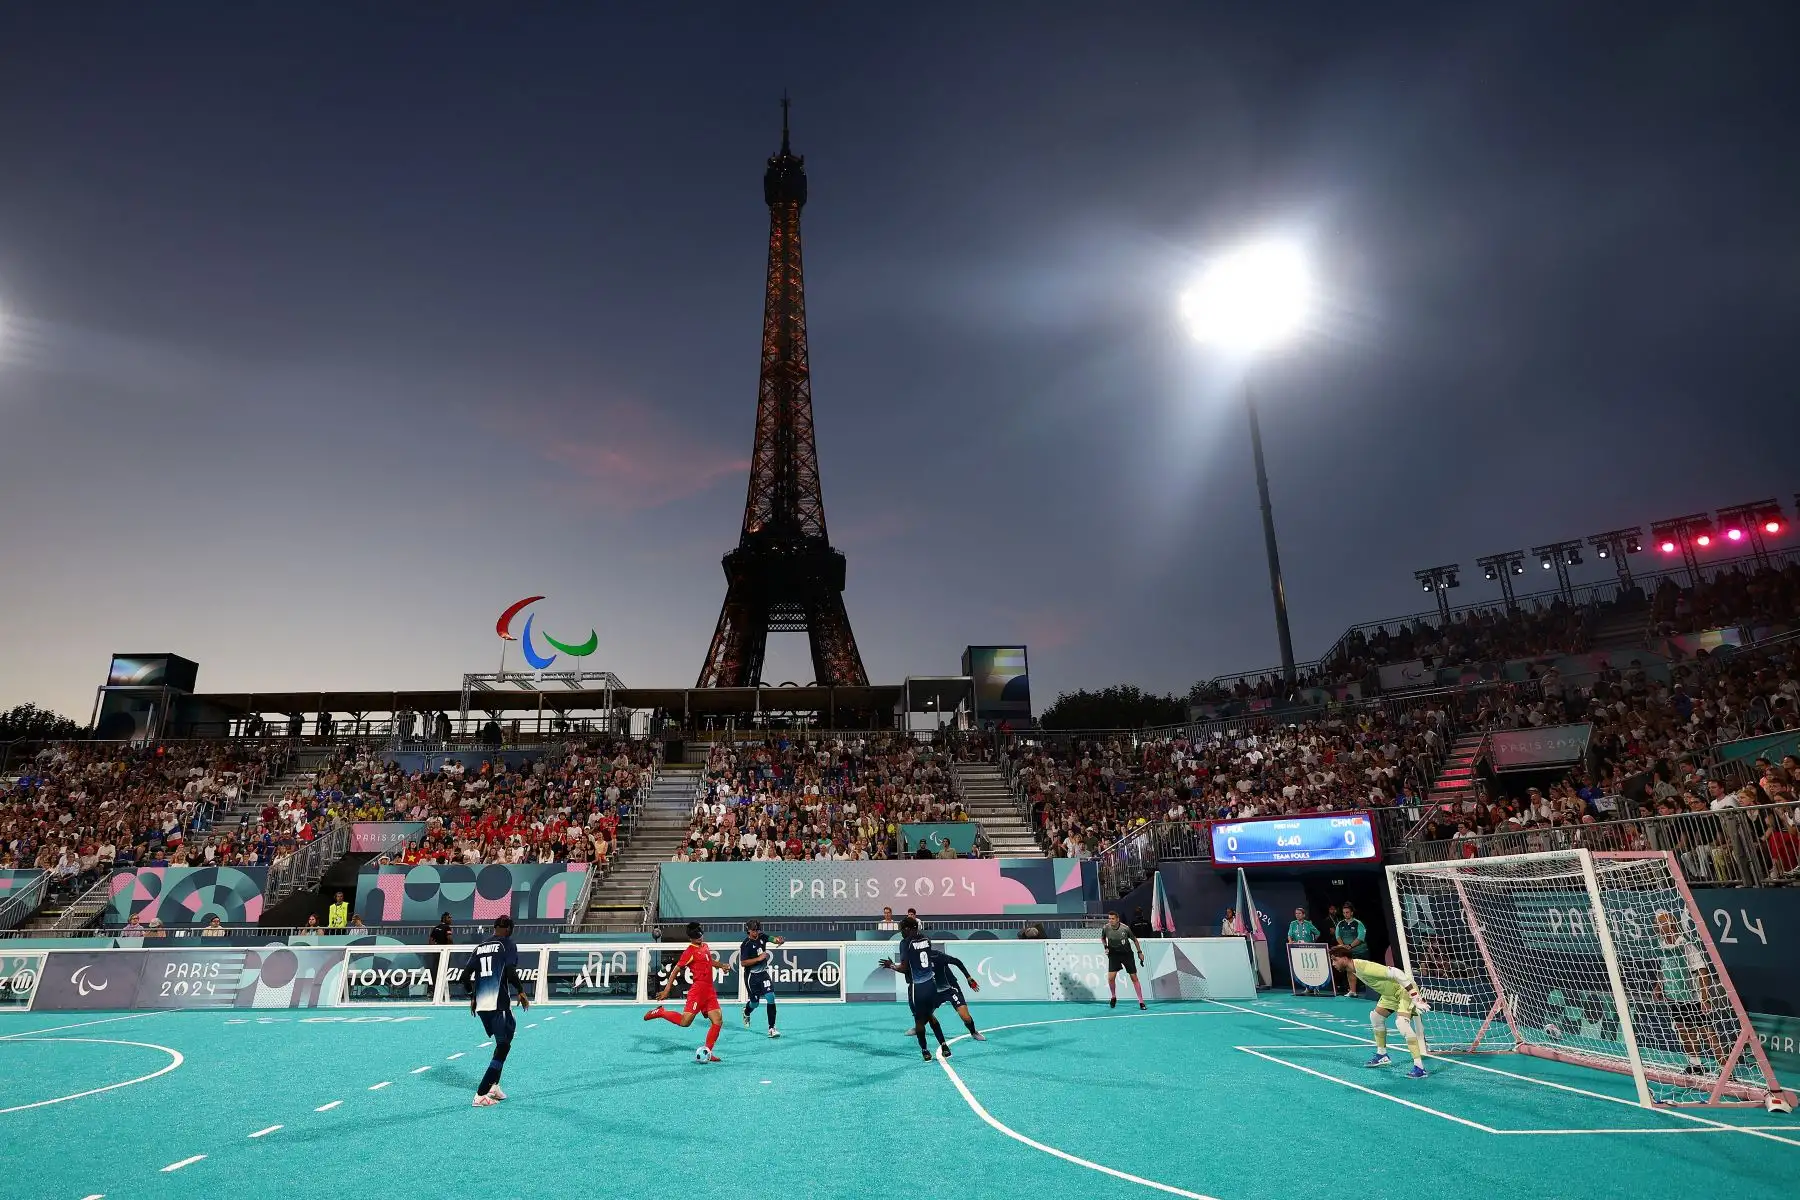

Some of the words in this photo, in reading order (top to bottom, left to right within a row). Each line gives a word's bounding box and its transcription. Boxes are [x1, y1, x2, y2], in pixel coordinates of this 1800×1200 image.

[1227, 836, 1238, 851] 0
[1277, 835, 1301, 847] 6:40
[1344, 830, 1355, 845] 0
[894, 876, 976, 897] 2024
[480, 956, 493, 978] 11
[920, 951, 929, 968] 9
[348, 968, 434, 986] TOYOTA
[160, 980, 216, 997] 2024
[692, 1001, 698, 1011] 8
